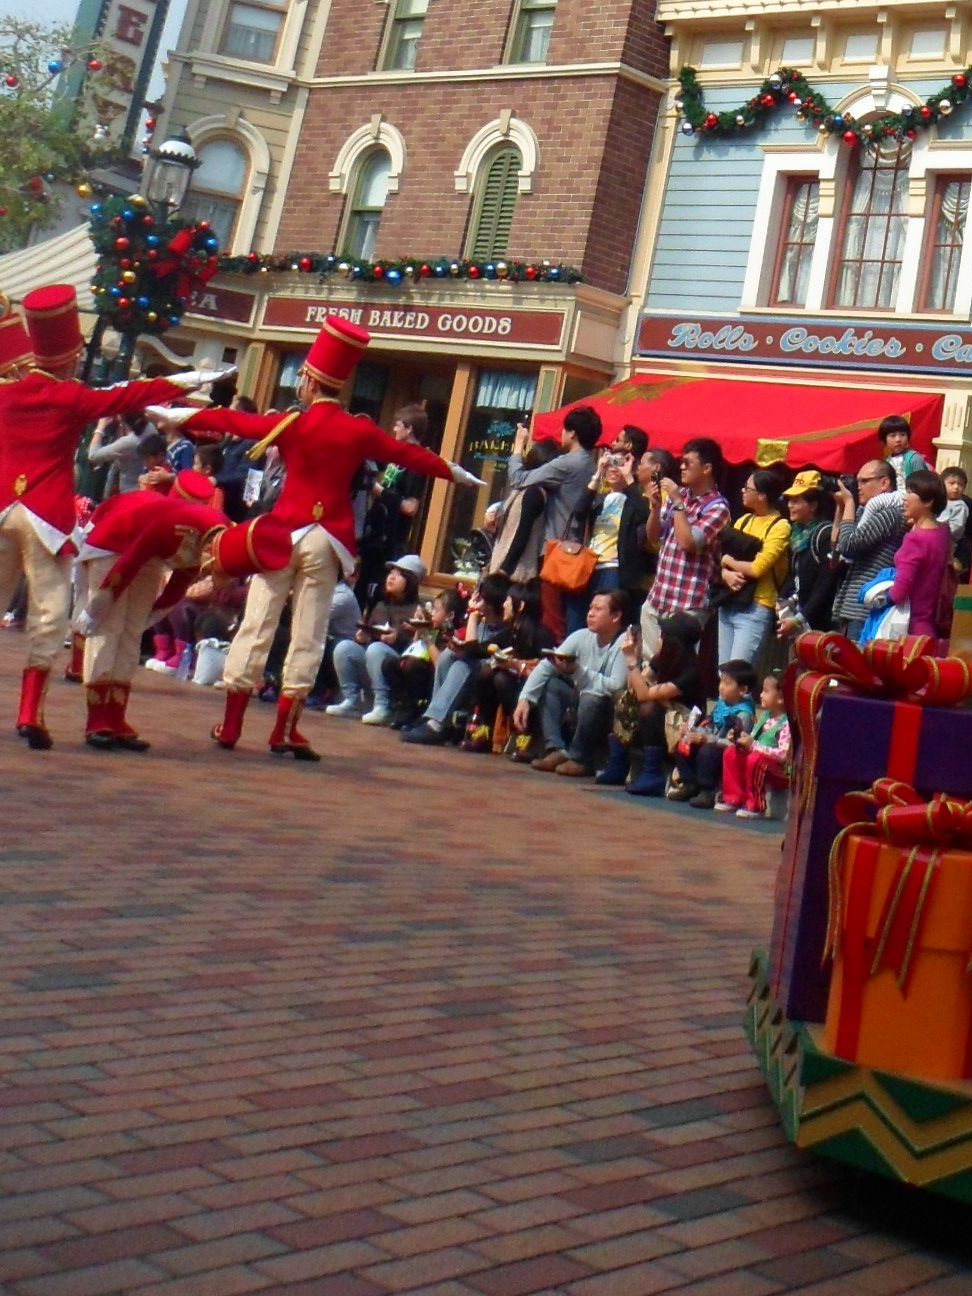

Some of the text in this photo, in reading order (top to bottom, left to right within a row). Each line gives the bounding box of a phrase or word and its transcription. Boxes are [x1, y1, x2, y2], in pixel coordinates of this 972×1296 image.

[305, 306, 512, 335] FRESH BAKED GOODS
[667, 322, 759, 351] Rolls
[779, 327, 907, 358] Cookies
[469, 439, 515, 452] BAKE
